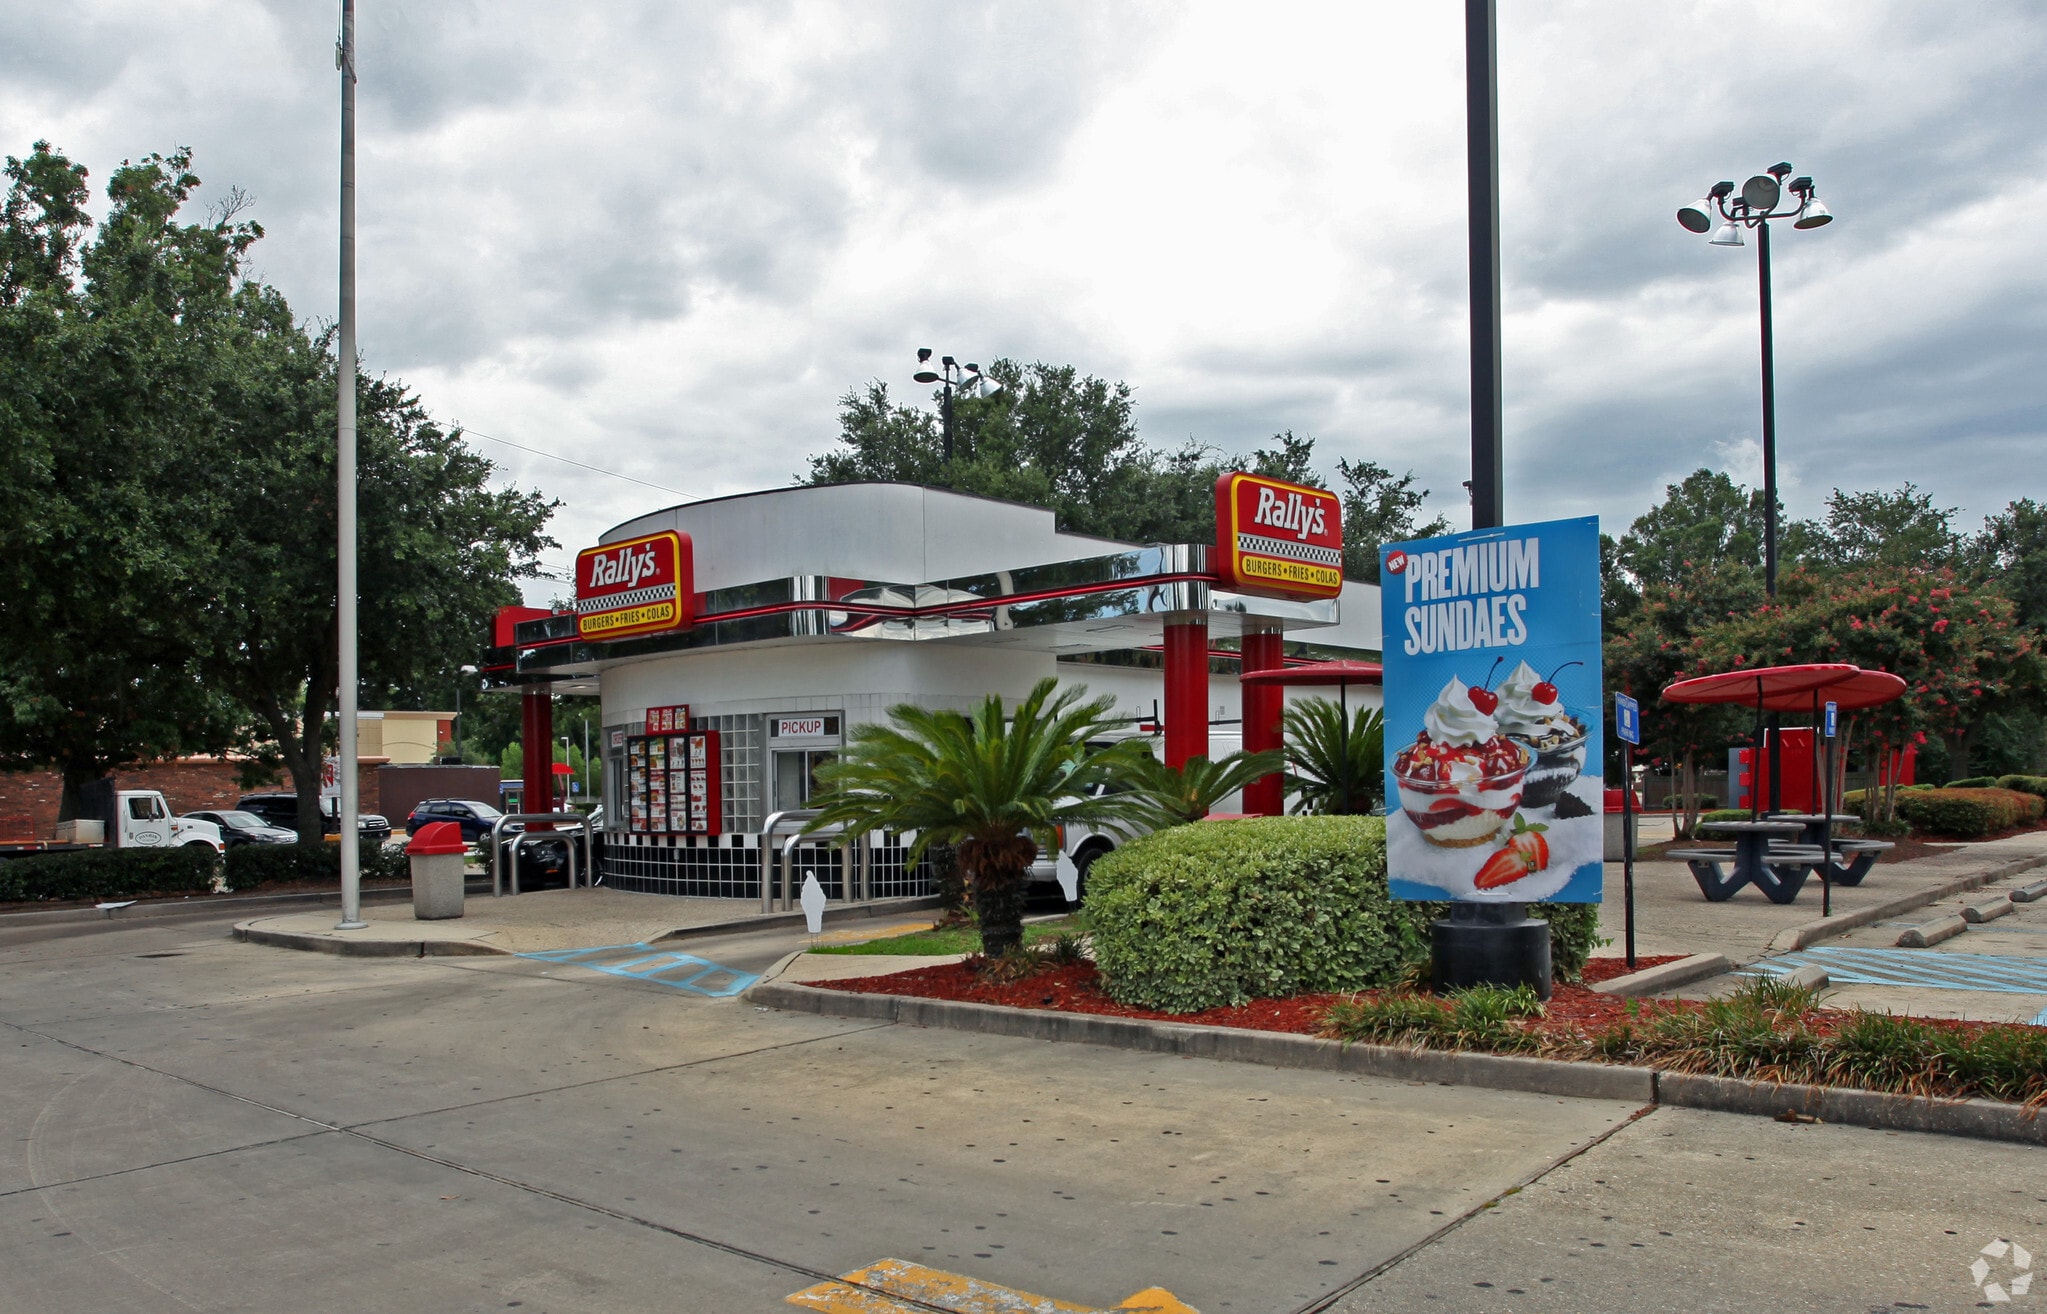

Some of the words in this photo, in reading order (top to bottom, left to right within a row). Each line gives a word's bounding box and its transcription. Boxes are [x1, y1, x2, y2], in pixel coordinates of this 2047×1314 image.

[1254, 487, 1325, 540] Rally's
[589, 543, 656, 588] Rally's
[1245, 558, 1282, 577] BURGERS
[1288, 565, 1310, 581] FRIES
[1315, 569, 1338, 585] COLAS
[1388, 554, 1405, 571] NEW
[1405, 537, 1540, 604] PREMIUM
[582, 614, 615, 631] BURGERS
[620, 610, 640, 625] FRIES
[646, 605, 670, 619] COLAS
[1404, 593, 1528, 656] SUNDAES
[781, 720, 822, 734] PICKUP
